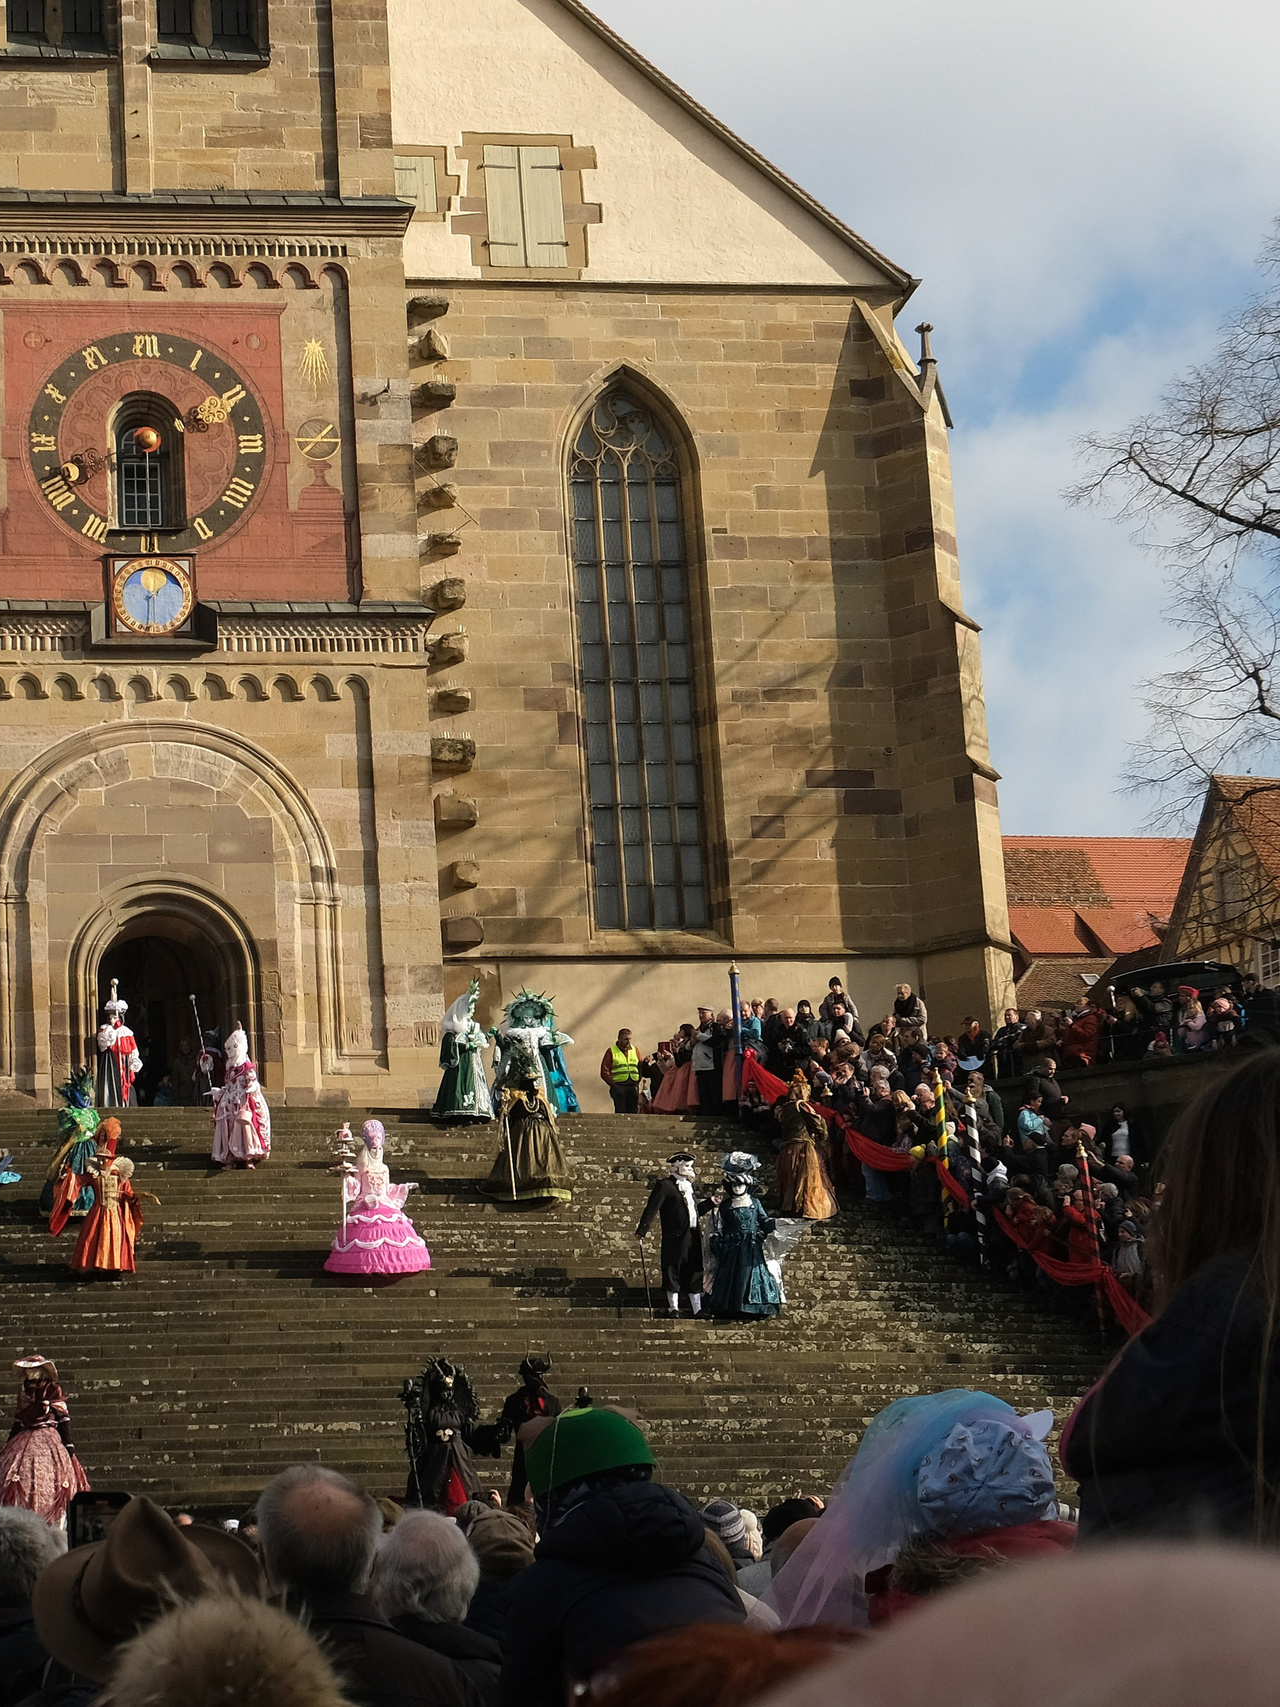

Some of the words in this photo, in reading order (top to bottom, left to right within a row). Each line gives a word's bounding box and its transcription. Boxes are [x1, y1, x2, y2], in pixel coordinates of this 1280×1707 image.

[132, 334, 161, 358] XII
[82, 345, 108, 370] XI
[189, 349, 203, 371] I
[44, 383, 67, 404] X
[31, 432, 57, 453] IX
[238, 433, 264, 455] III
[221, 476, 255, 509] IIII
